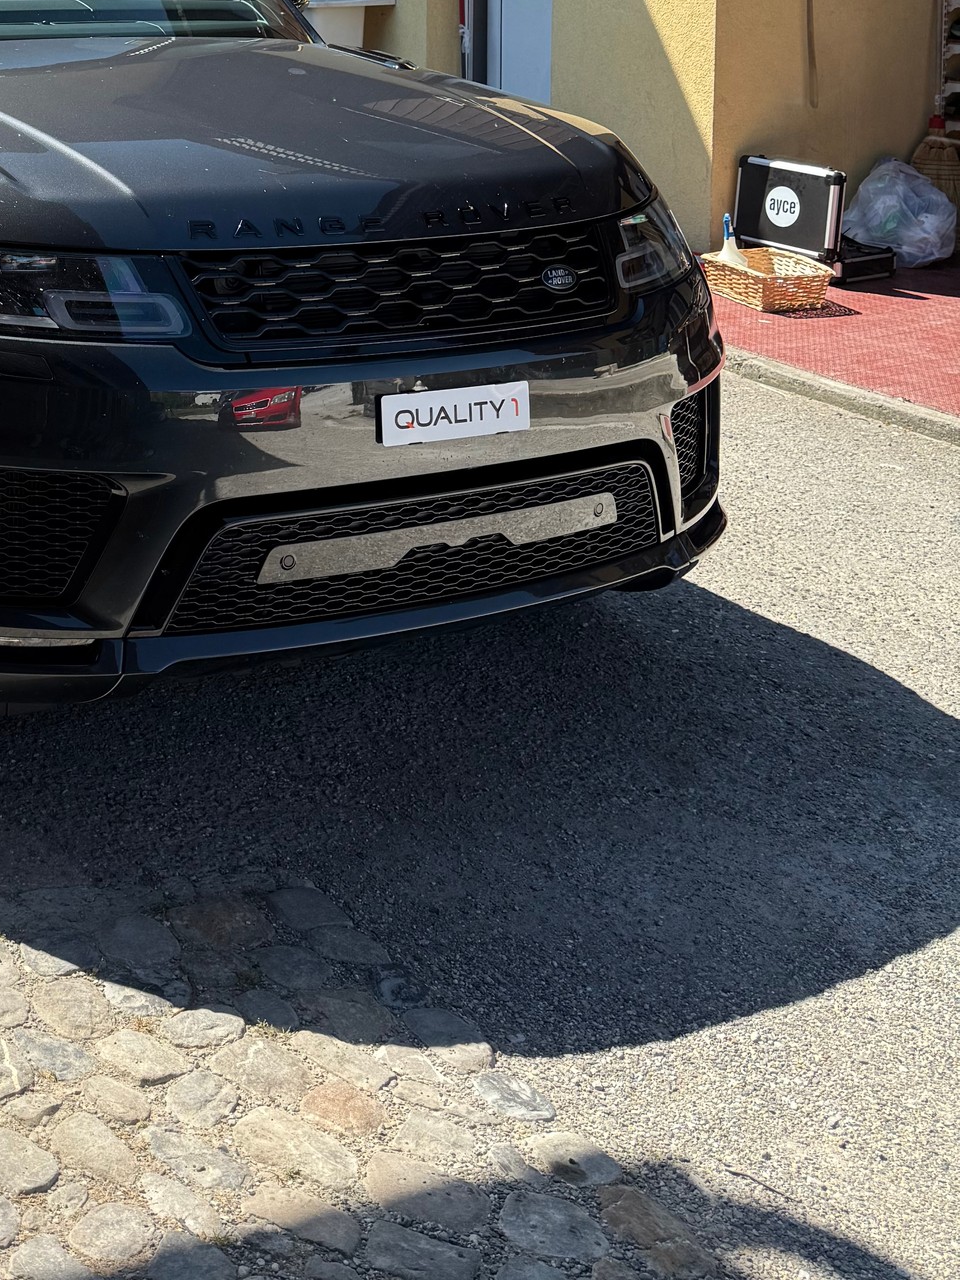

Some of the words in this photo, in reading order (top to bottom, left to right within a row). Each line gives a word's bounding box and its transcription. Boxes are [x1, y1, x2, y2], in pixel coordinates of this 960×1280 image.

[769, 198, 796, 215] ayce
[188, 215, 385, 240] RANGE
[423, 197, 576, 227] ROVER
[547, 269, 566, 277] LAND
[552, 276, 573, 285] ROVER
[394, 399, 506, 429] QUALITY
[511, 397, 519, 417] 1
